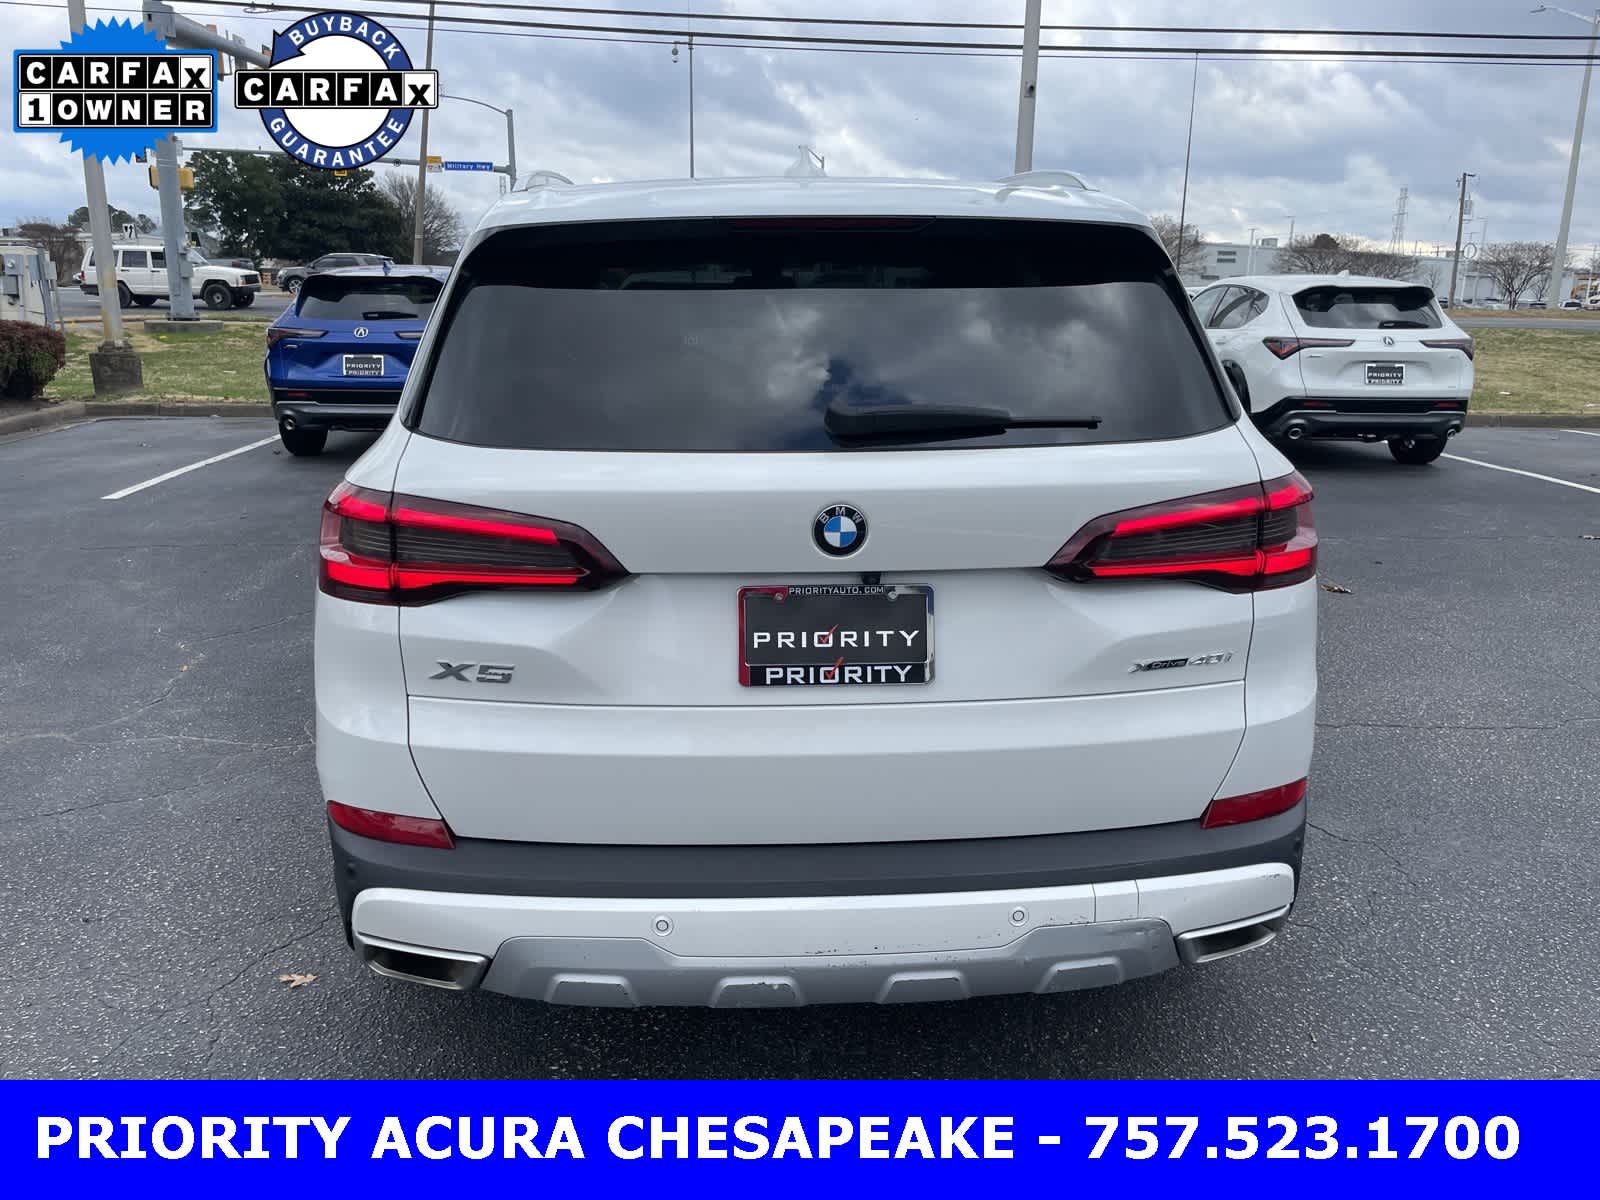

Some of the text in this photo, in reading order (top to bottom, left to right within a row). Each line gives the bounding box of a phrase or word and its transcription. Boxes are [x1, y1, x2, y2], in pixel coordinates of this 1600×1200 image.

[819, 506, 863, 524] BMW
[753, 630, 920, 648] PRIORITY
[428, 661, 516, 684] X5
[765, 664, 913, 685] PRIORITY
